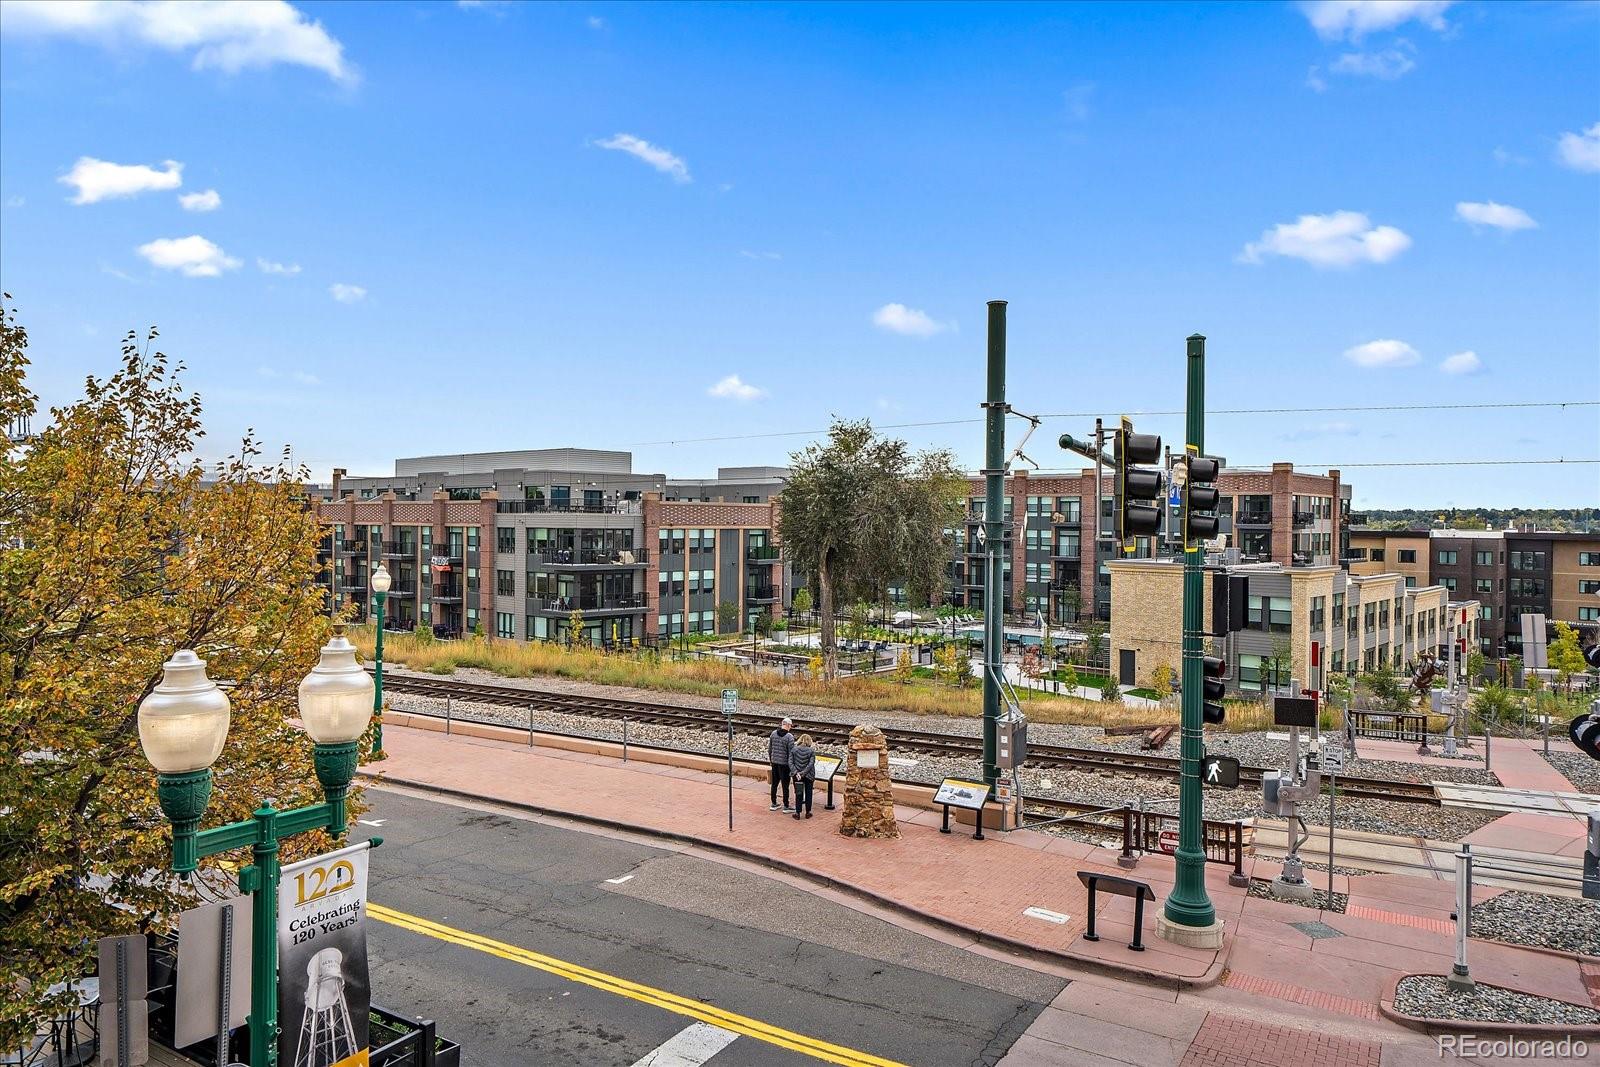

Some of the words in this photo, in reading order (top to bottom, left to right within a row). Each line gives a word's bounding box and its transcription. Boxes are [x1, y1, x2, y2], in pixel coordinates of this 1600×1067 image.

[294, 860, 356, 906] 120
[289, 899, 360, 931] Celebrating
[293, 928, 316, 946] 120
[320, 912, 358, 935] Years!
